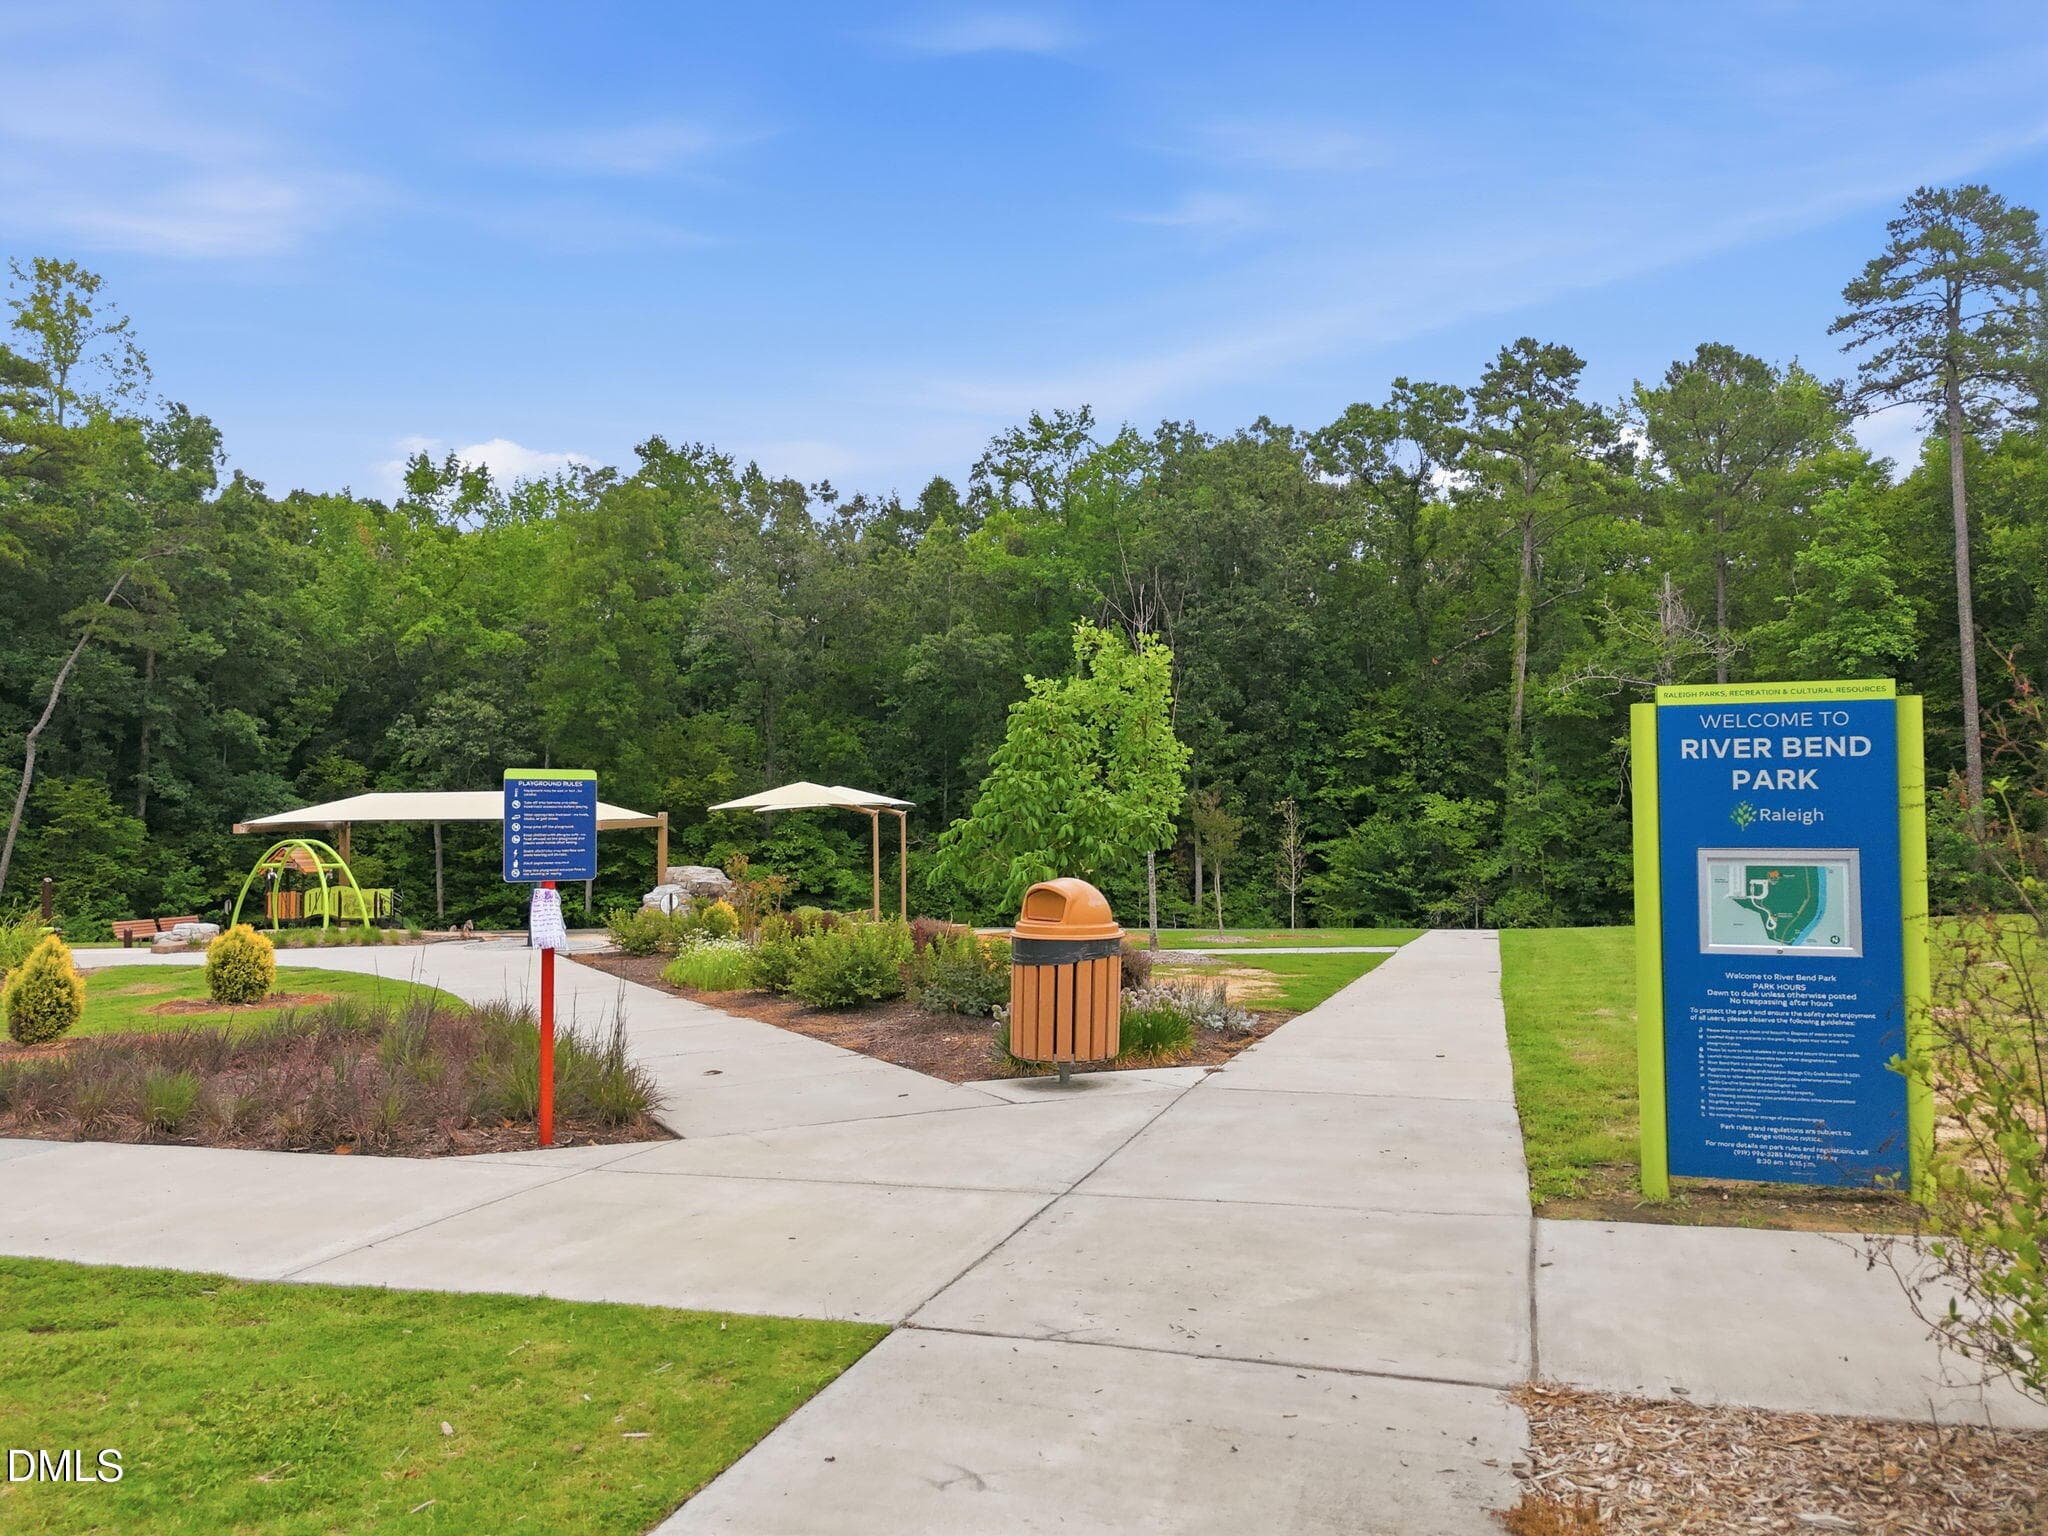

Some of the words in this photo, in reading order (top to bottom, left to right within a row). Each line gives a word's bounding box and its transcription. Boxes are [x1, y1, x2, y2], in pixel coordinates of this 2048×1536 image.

[1699, 690, 1728, 698] PARKS,
[1790, 687, 1833, 695] CULTURAL
[1699, 712, 1813, 729] WELCOME
[1819, 711, 1850, 727] TO
[1680, 737, 1772, 759] RIVER
[1782, 736, 1872, 758] BEND
[1732, 768, 1819, 791] PARK
[1759, 808, 1824, 825] Raleigh
[1763, 973, 1773, 981] to
[1796, 974, 1817, 982] Bend
[1753, 983, 1775, 991] PARK
[1741, 990, 1760, 998] dusk
[1761, 991, 1786, 999] unless
[1787, 992, 1827, 1000] otherwise
[1828, 993, 1857, 1002] posted
[1742, 998, 1788, 1008] trespassing
[1789, 999, 1809, 1007] after
[1810, 1000, 1834, 1008] hours
[1699, 1008, 1724, 1016] protect
[1738, 1009, 1753, 1017] park
[1804, 1011, 1826, 1020] safety
[1840, 1012, 1876, 1021] enjoyment
[1727, 1016, 1748, 1025] please
[1789, 1018, 1820, 1027] following
[1736, 1124, 1752, 1132] rules
[1767, 1126, 1804, 1136] regulations
[1748, 1133, 1772, 1142] change
[1736, 1142, 1759, 1150] details
[1769, 1144, 1784, 1153] park
[1784, 1153, 1812, 1162] Monday
